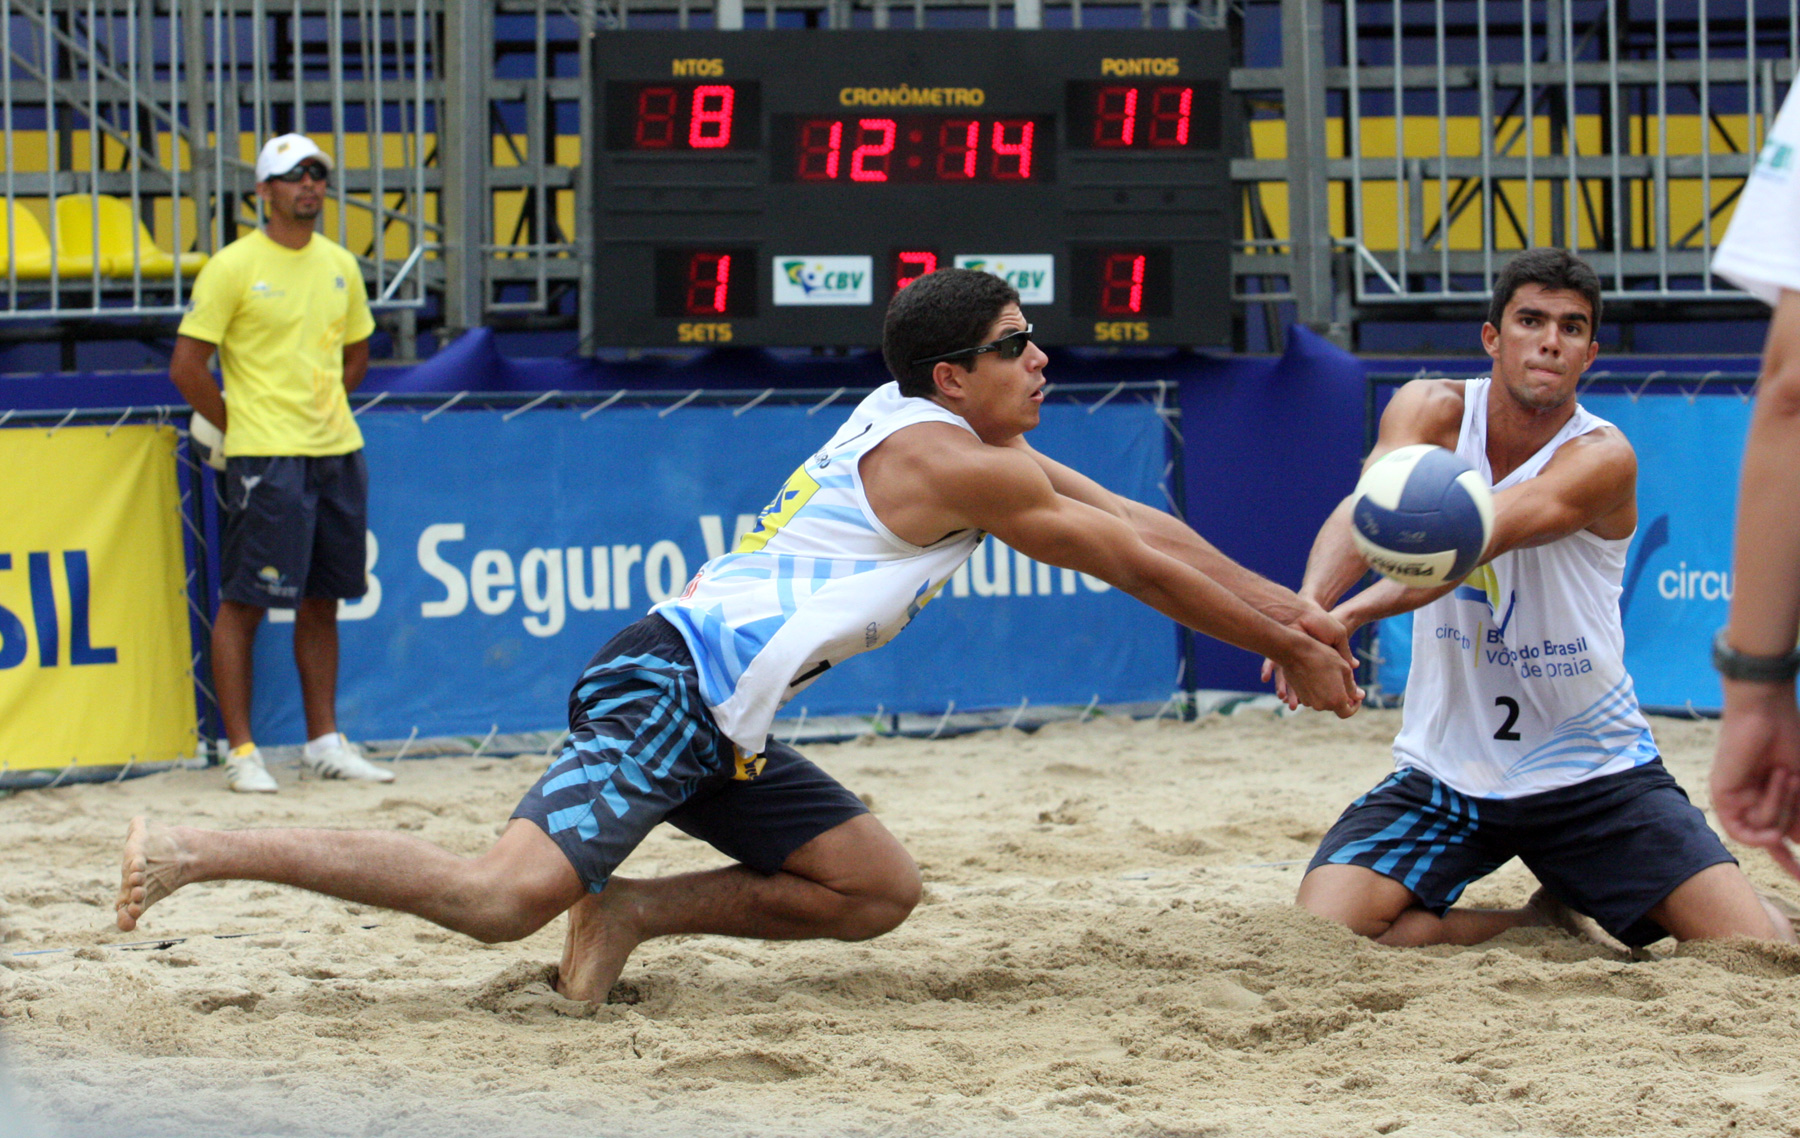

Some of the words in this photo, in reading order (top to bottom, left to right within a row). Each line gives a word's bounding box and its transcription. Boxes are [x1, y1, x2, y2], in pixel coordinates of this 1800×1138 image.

[672, 58, 725, 77] NTOS
[1101, 58, 1179, 76] PONTOS
[839, 84, 986, 106] CRONÔMETRO
[689, 85, 735, 148] 8
[1121, 88, 1193, 145] 11
[713, 254, 731, 312] 1
[824, 271, 865, 290] CBV
[1006, 270, 1045, 289] CBV
[1128, 254, 1146, 312] 1
[677, 323, 733, 341] SETS
[1094, 322, 1149, 341] SETS
[417, 523, 687, 637] Seguro
[1658, 561, 1736, 600] circu
[1519, 645, 1540, 660] do
[1544, 636, 1588, 656] Brasil
[1520, 662, 1543, 679] de
[1546, 657, 1593, 678] praia
[1493, 695, 1521, 741] 2
